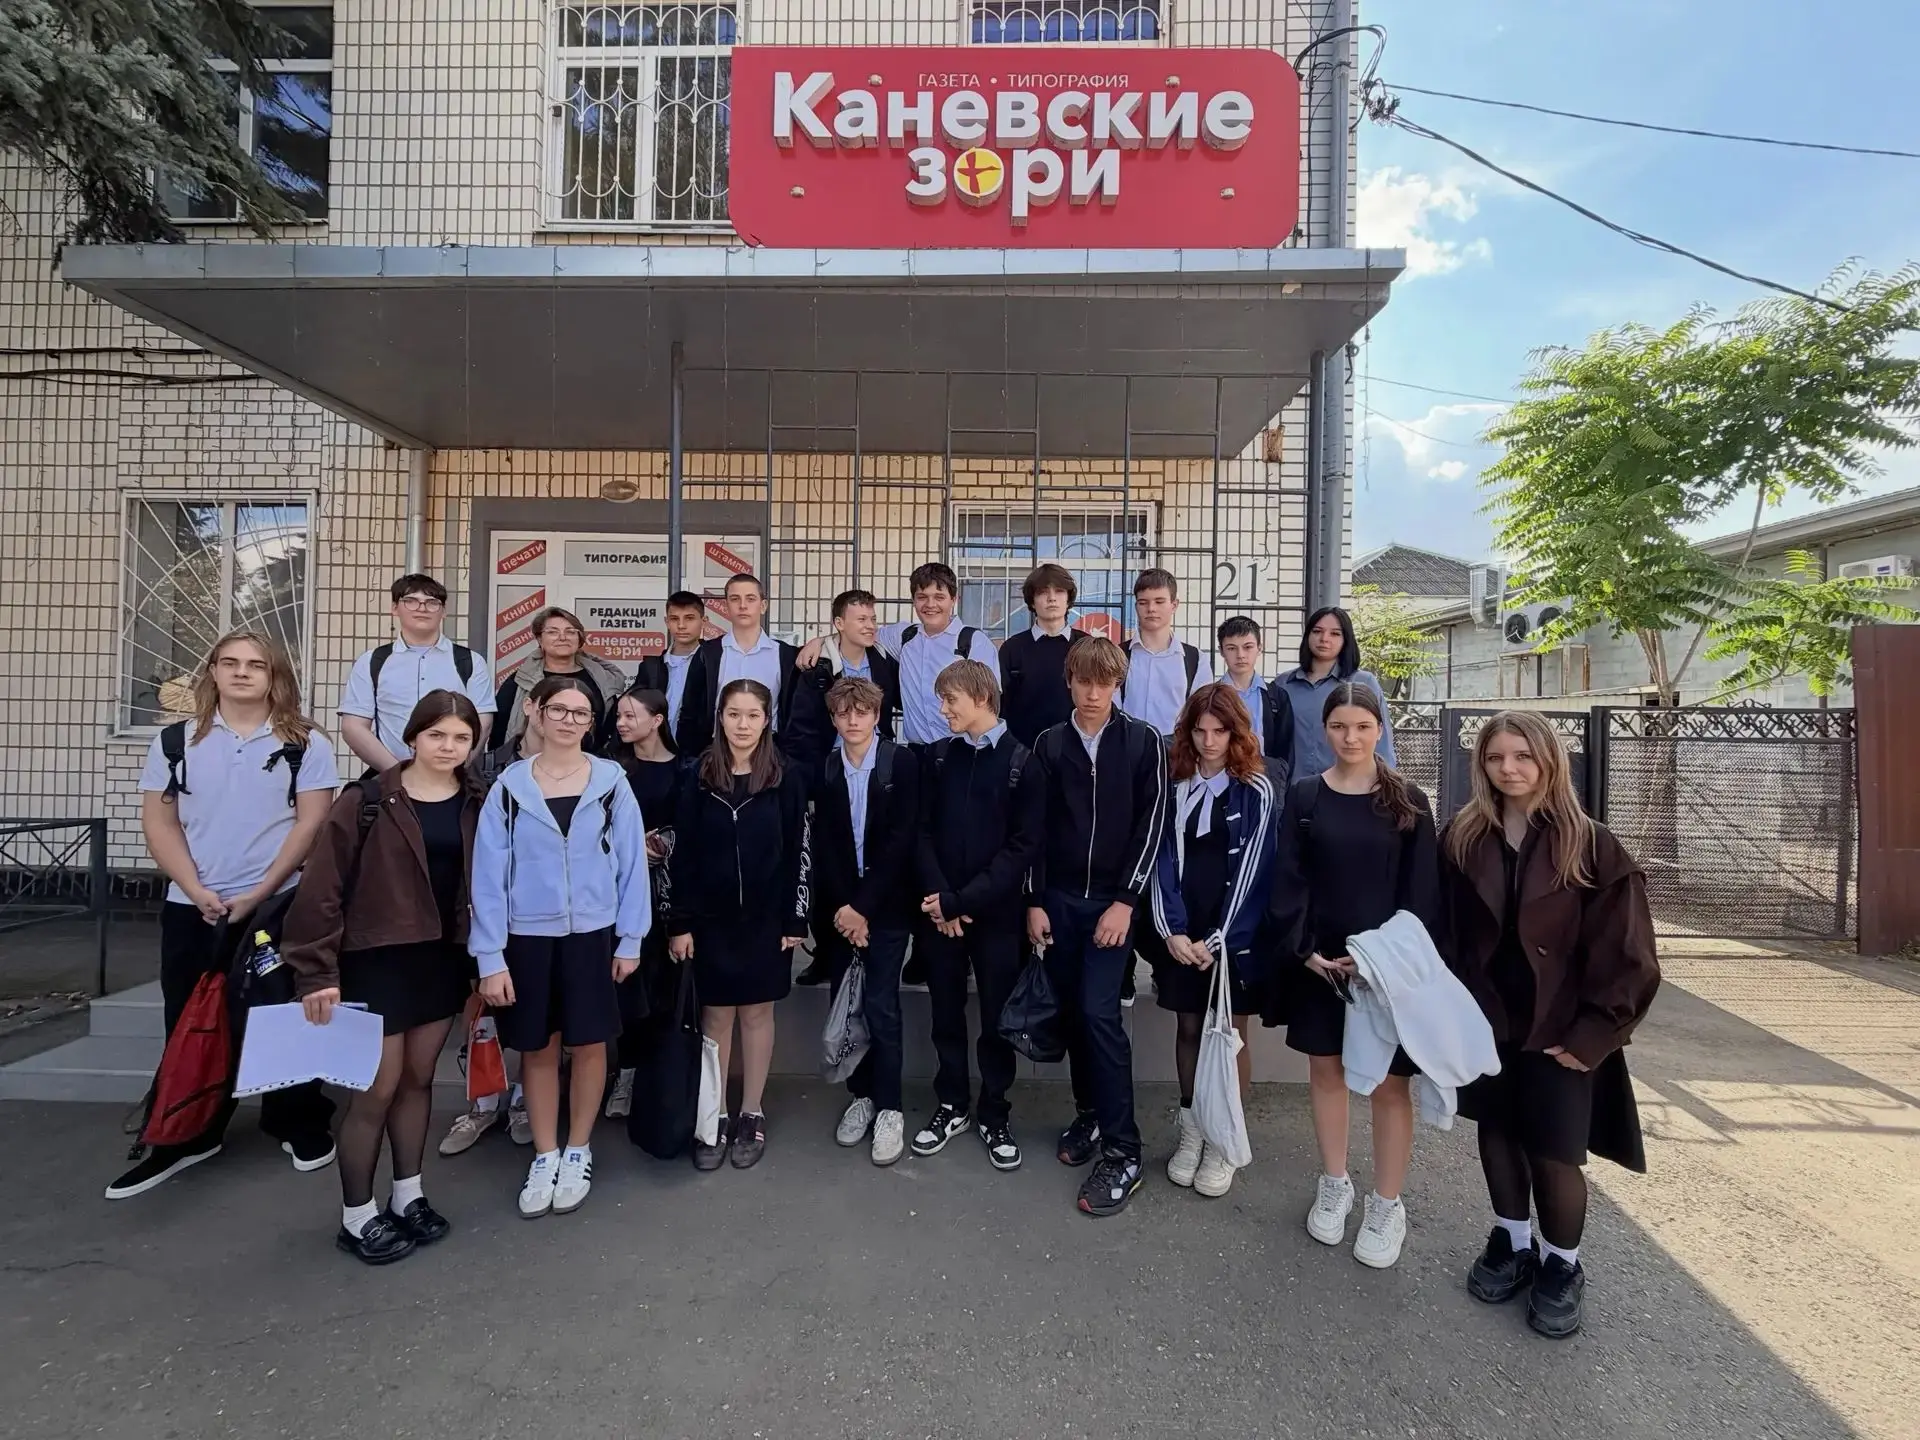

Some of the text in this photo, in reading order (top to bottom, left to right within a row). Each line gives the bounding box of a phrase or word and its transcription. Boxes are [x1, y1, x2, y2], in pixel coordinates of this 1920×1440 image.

[918, 73, 1129, 89] ГАЗЕТА ТИПОГРАФИЯ
[773, 72, 1254, 149] Каневские
[905, 147, 1120, 226] зори
[502, 543, 545, 571] печати
[584, 553, 667, 564] ТИПОГРАФИЯ
[708, 547, 750, 575] штампы
[1215, 562, 1260, 601] 21
[503, 598, 539, 622] книги
[590, 608, 656, 618] РЕДАКЦИЯ
[600, 619, 645, 629] ГАЗЕТЫ
[604, 646, 641, 659] зори
